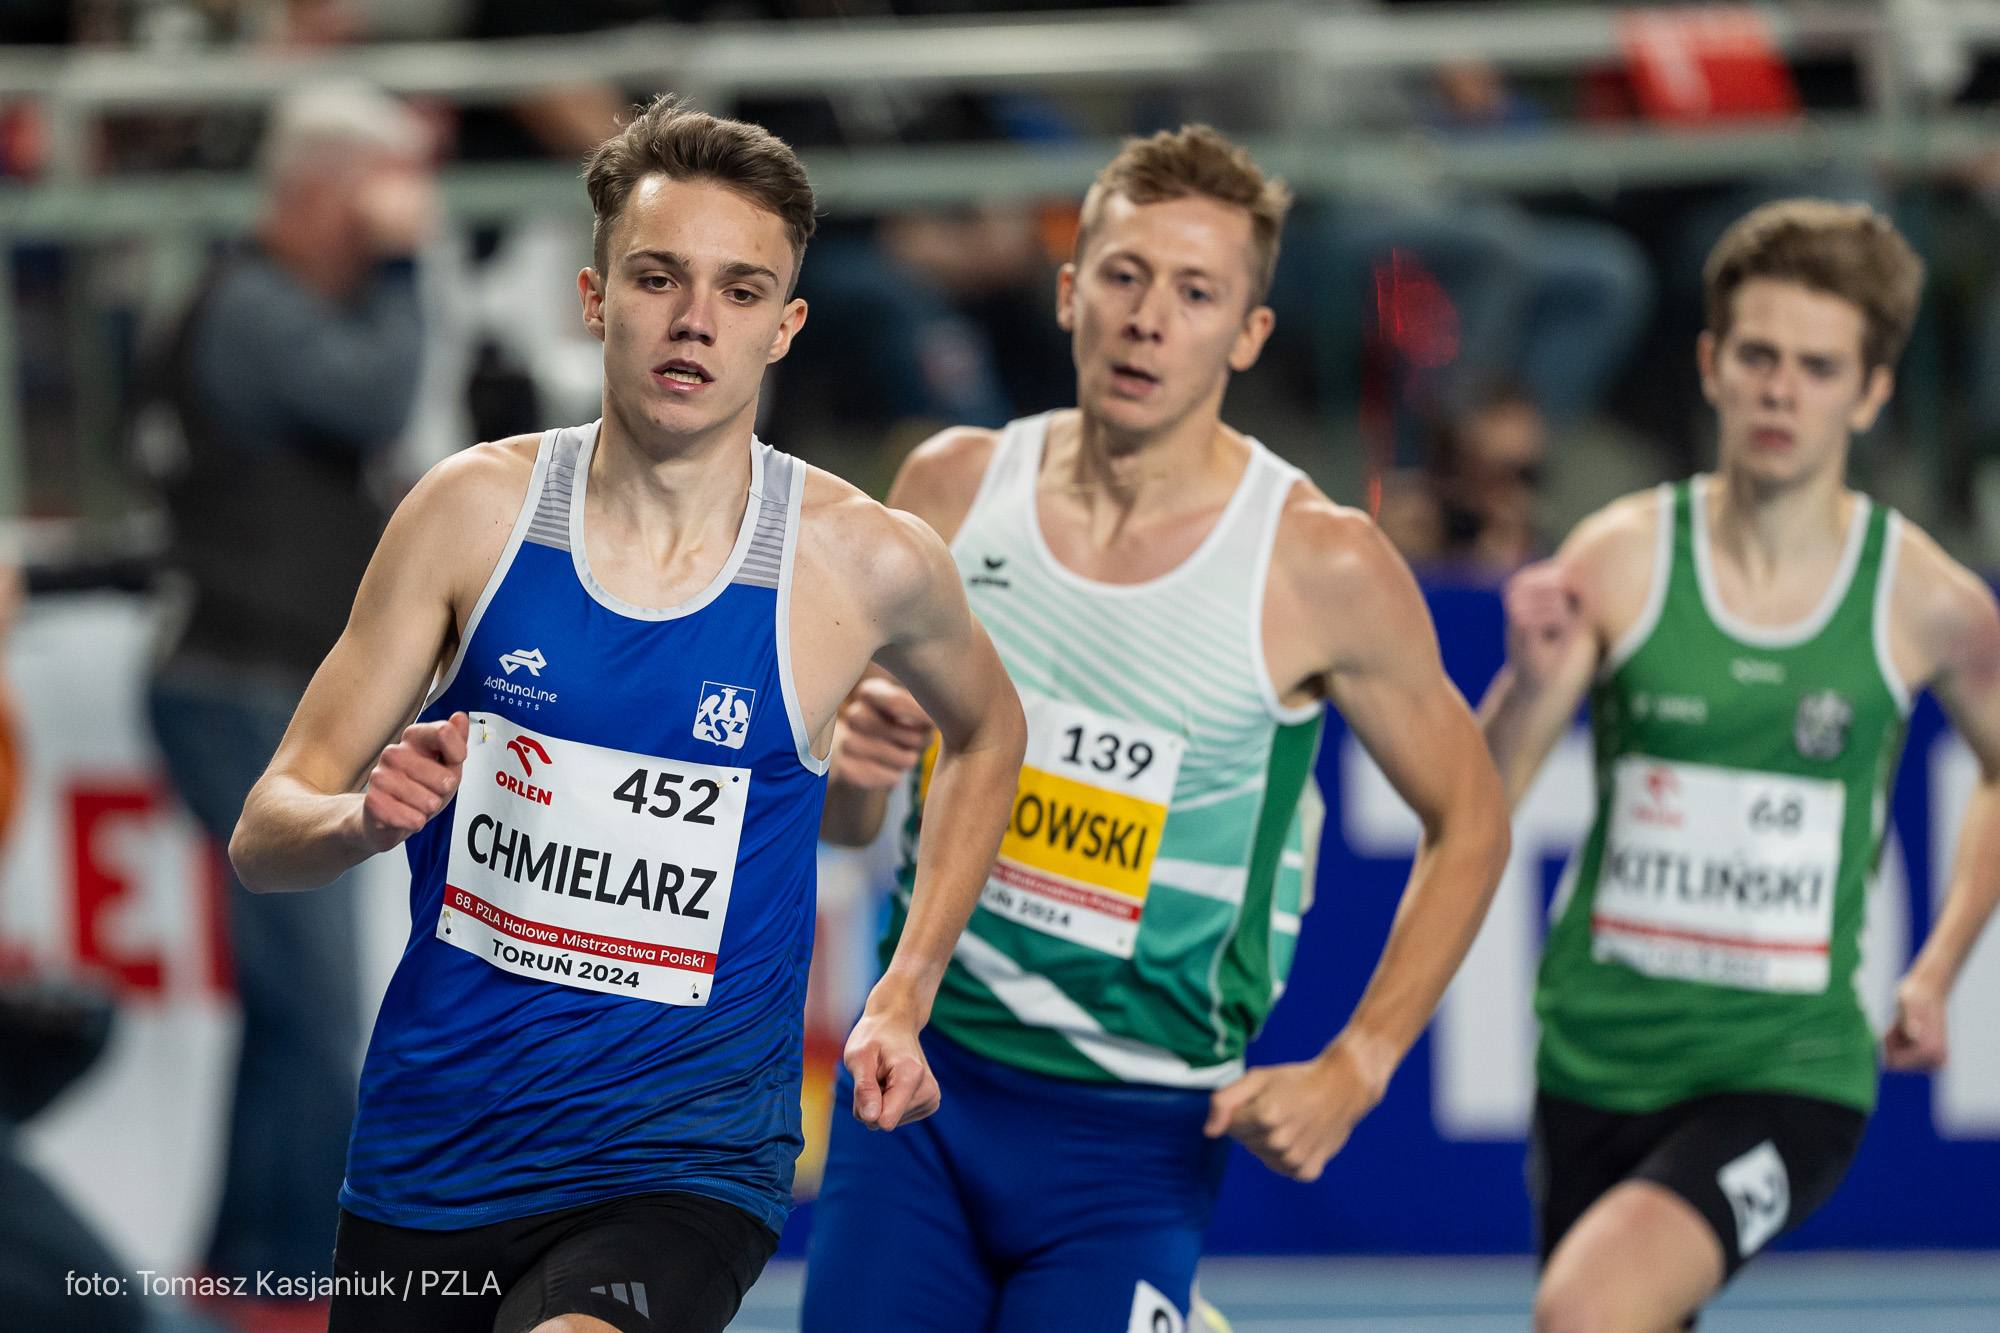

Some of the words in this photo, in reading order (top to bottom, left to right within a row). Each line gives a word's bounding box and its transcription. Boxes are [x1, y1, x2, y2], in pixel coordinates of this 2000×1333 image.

[493, 693, 540, 711] SPORTS
[1061, 725, 1154, 780] 139
[495, 770, 552, 806] ORLEN
[613, 768, 721, 826] 452
[1006, 793, 1147, 871] OWSKI
[467, 813, 717, 920] CHMIELARZ
[455, 892, 473, 912] 68.
[476, 904, 501, 926] PZLA
[503, 916, 559, 943] Halowe
[562, 932, 656, 961] Mistrzostwa
[659, 949, 706, 968] Polski
[492, 938, 573, 976] TORUŃ
[577, 961, 640, 988] 2024
